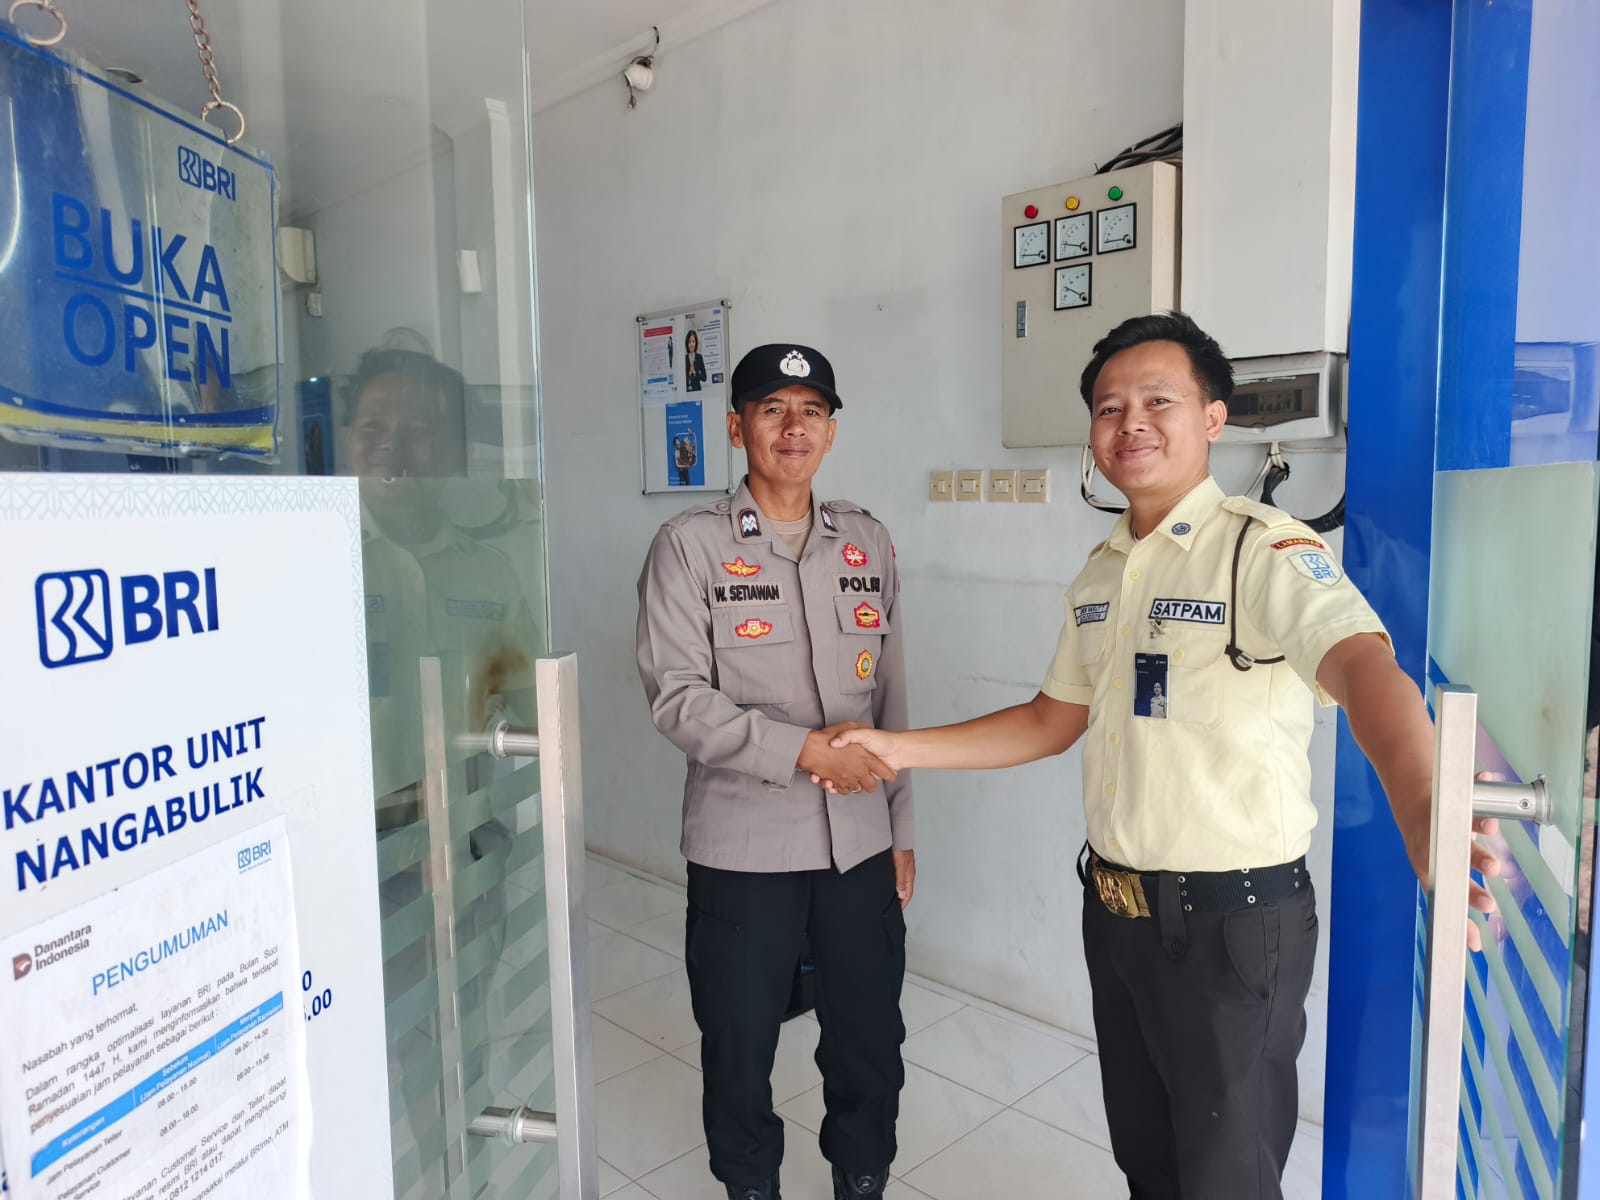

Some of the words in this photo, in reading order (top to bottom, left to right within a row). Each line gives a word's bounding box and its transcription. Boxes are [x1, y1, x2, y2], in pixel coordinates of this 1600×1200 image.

[203, 158, 236, 201] BRI
[53, 191, 231, 313] BUKA
[63, 292, 231, 388] OPEN
[120, 567, 220, 646] BRI
[714, 586, 727, 602] W.
[730, 584, 780, 601] SETIAWAN
[1153, 602, 1222, 621] SATPAM
[1312, 569, 1337, 579] BRI
[2, 744, 178, 830] KANTOR
[187, 716, 266, 769] UNIT
[15, 766, 265, 892] NANGABULIK
[253, 840, 271, 861] BRI
[34, 925, 92, 957] Danantara
[35, 938, 90, 971] Indonesia
[92, 909, 228, 996] PENGUMUMAN
[22, 1042, 68, 1073] Nasabah
[70, 1028, 94, 1049] yang
[95, 1002, 138, 1033] terhormat,
[25, 1075, 58, 1100] Dalam
[66, 1050, 100, 1076] rangka
[107, 1016, 154, 1053] optimalisasi
[161, 996, 191, 1020] layanan
[197, 983, 211, 999] BRI
[217, 971, 234, 988] pada
[239, 957, 259, 974] Bulan
[264, 944, 279, 959] Suci
[28, 1081, 75, 1116] Ramadan
[84, 1061, 106, 1082] 1447
[128, 1037, 148, 1055] kami
[153, 993, 220, 1039] menginformasikan
[225, 977, 248, 995] bahwa
[252, 958, 279, 980] terdapat
[304, 988, 332, 1021] .00
[30, 1088, 92, 1136] penyesuaian
[93, 1076, 111, 1095] jam
[112, 1049, 155, 1083] pelayanan
[156, 1027, 188, 1052] sebagai
[158, 1171, 181, 1196] resmi
[183, 1158, 198, 1175] BRI
[201, 1144, 218, 1161] atau
[221, 1125, 241, 1146] dapat
[244, 1090, 287, 1128] menghubungi
[161, 1144, 197, 1178] Customer
[201, 1122, 228, 1146] Service
[231, 1109, 245, 1124] dan
[248, 1093, 265, 1111] Teller
[268, 1076, 286, 1097] dapat
[224, 1153, 249, 1179] melalui
[274, 1120, 289, 1138] ATM
[169, 1179, 189, 1200] 0812
[190, 1163, 208, 1183] 1214
